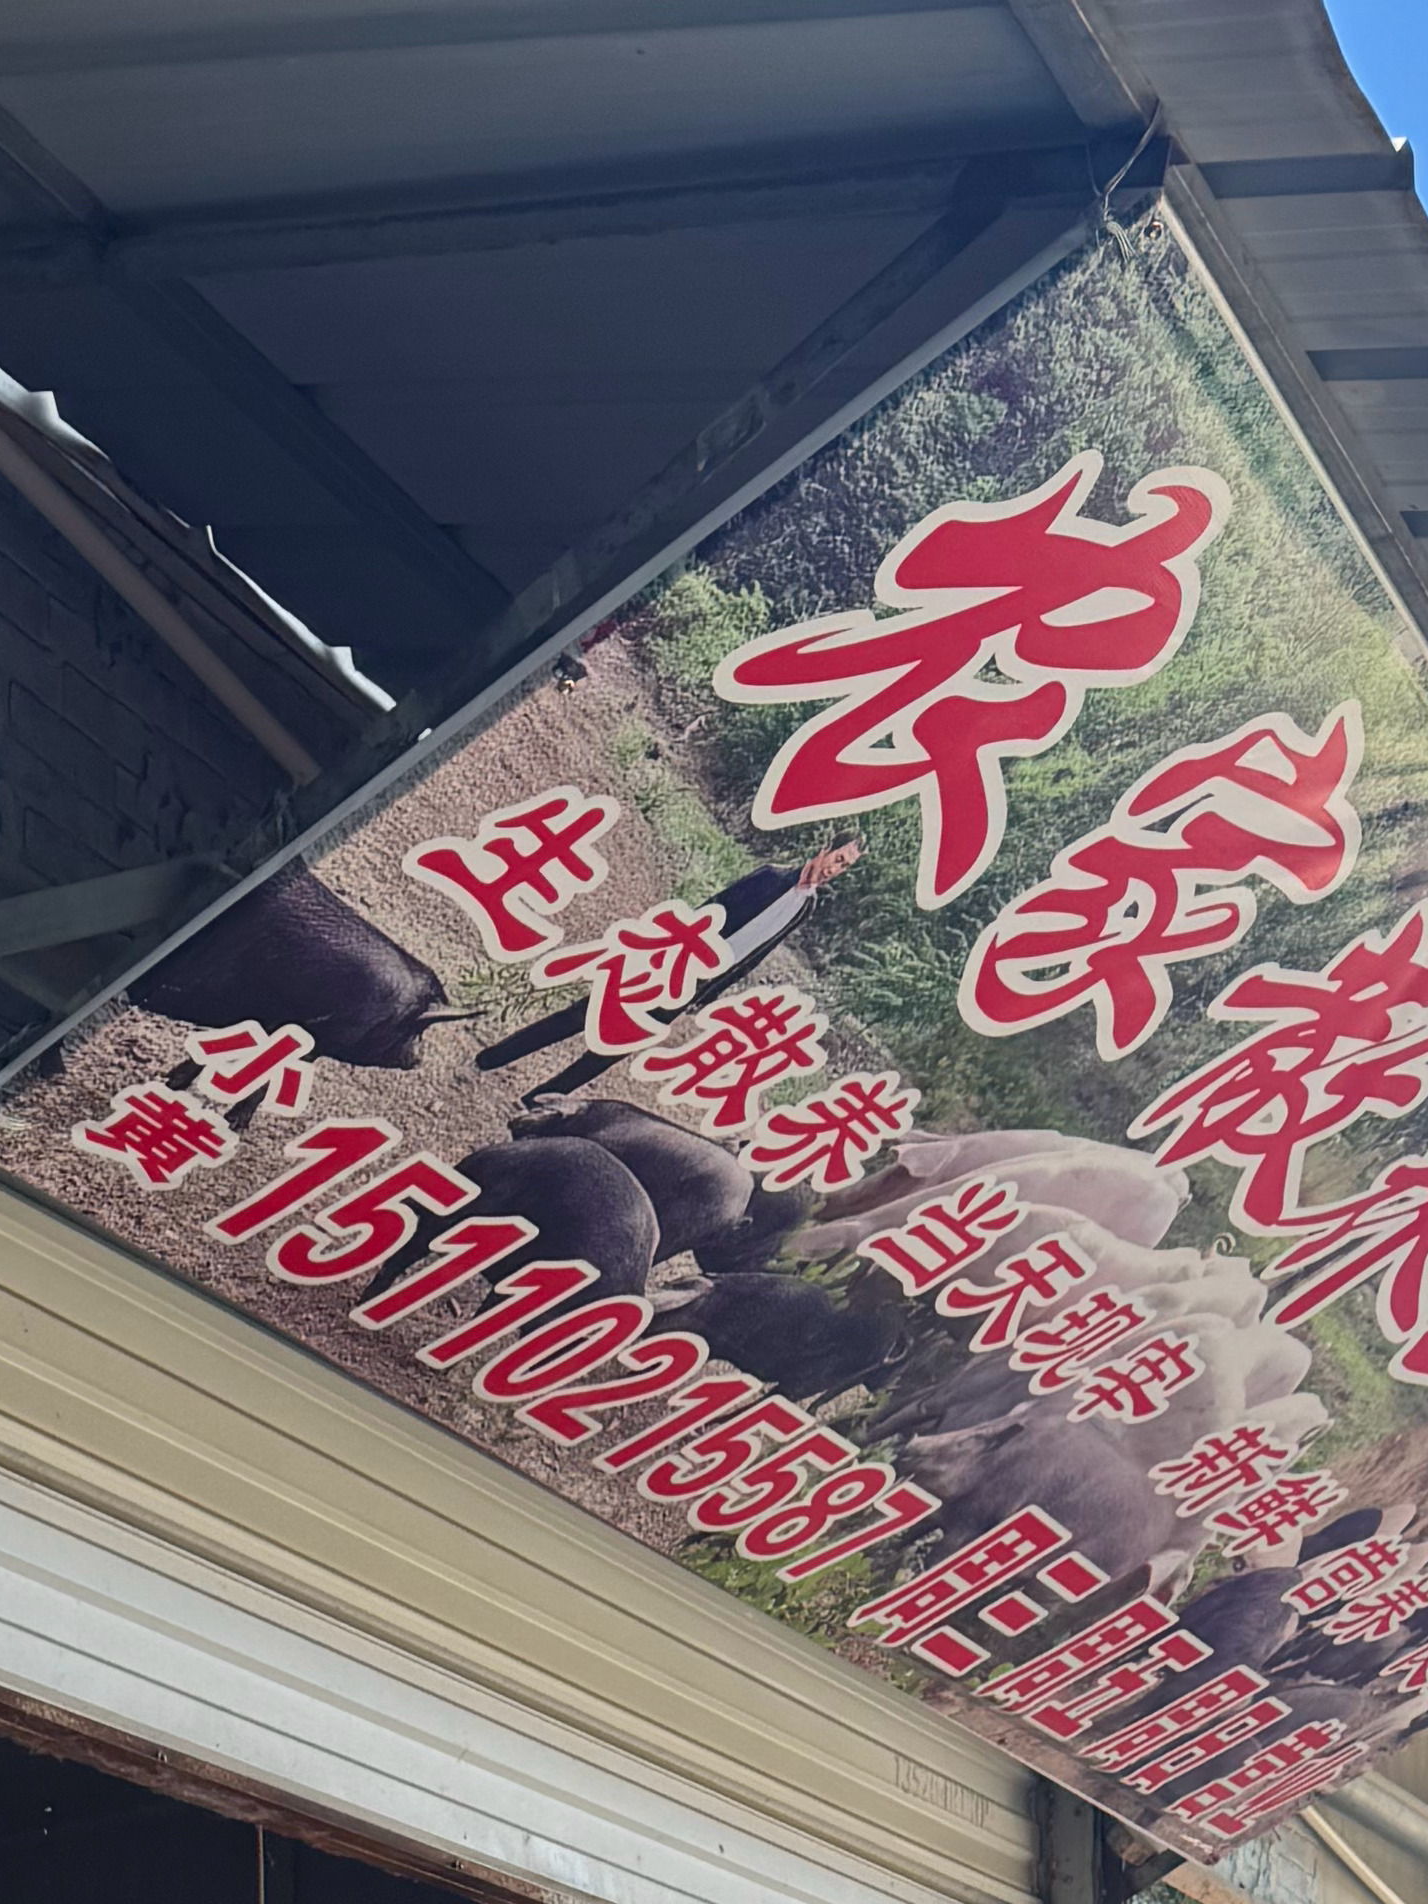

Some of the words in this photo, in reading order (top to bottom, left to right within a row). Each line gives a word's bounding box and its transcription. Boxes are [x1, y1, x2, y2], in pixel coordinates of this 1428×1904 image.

[73, 1021, 314, 1191] 小黄
[206, 1118, 941, 1582] 15110215587
[405, 786, 922, 1193] 生态散养
[858, 1175, 1206, 1423] 当天现宰
[1149, 1421, 1348, 1558] 新鲜
